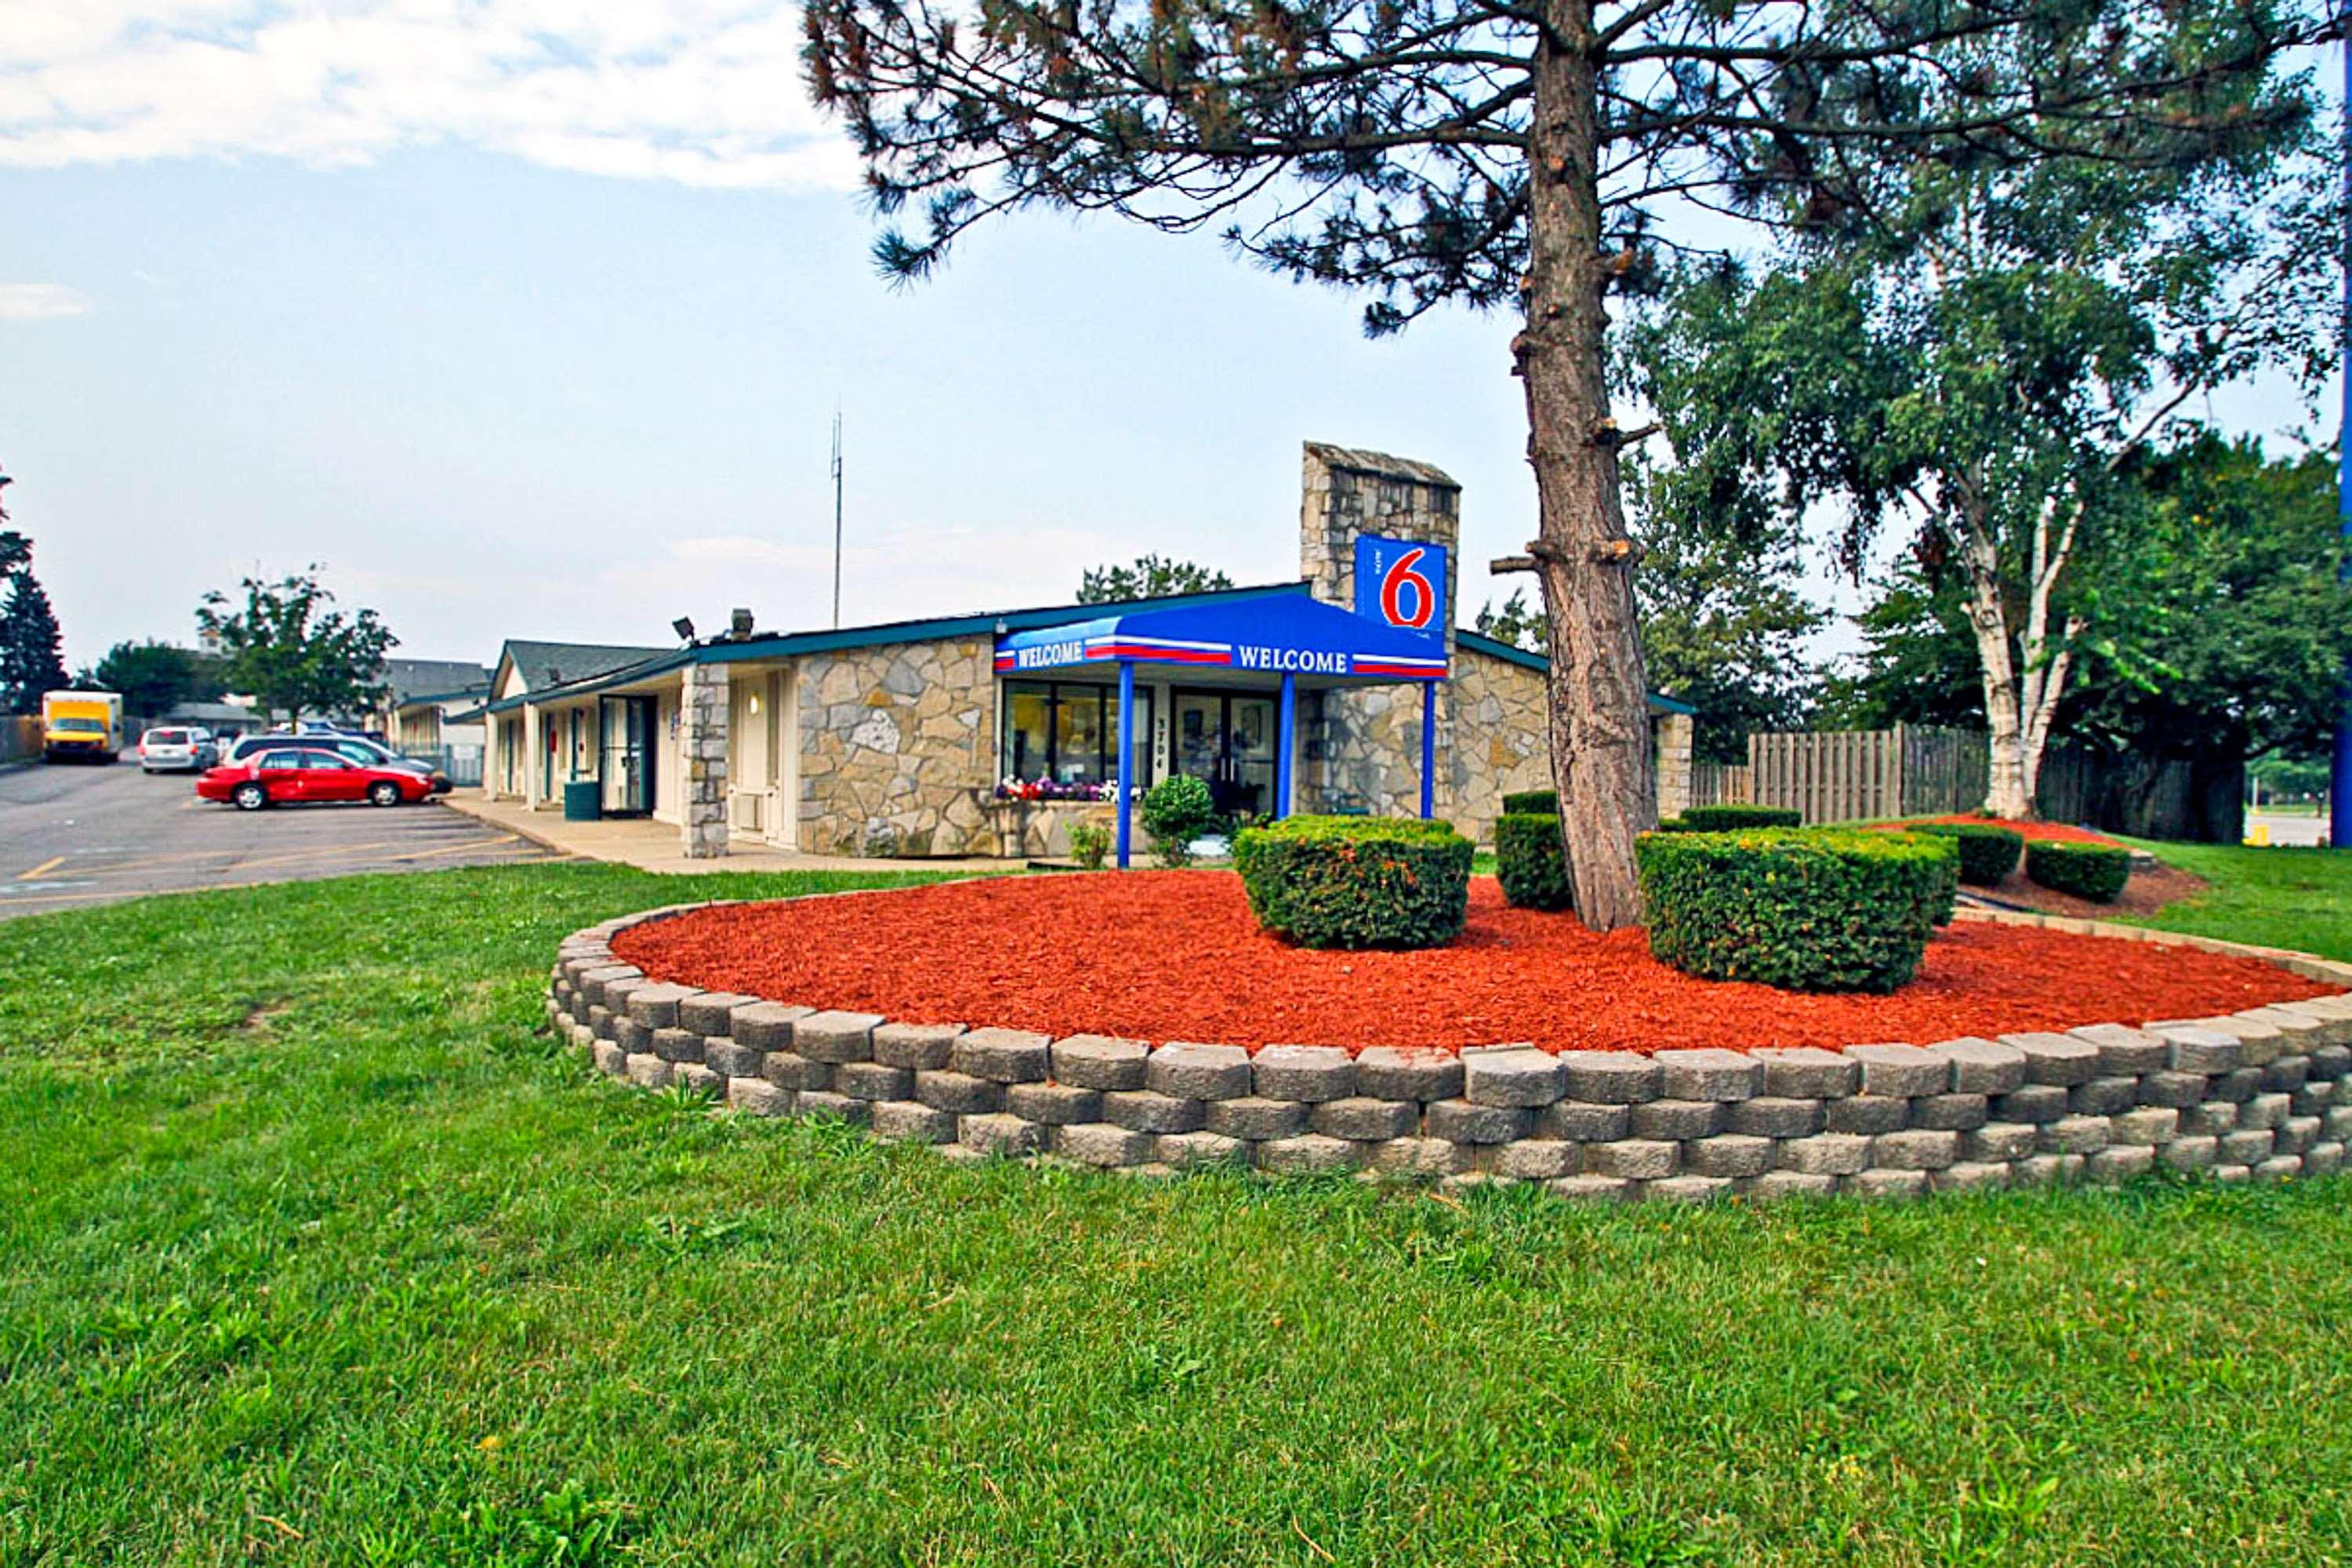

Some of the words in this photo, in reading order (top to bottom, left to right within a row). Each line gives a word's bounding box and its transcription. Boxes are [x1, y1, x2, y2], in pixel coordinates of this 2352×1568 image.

[1381, 547, 1435, 628] 6
[1018, 641, 1082, 667] WELCOME
[1239, 644, 1347, 673] WELCOME
